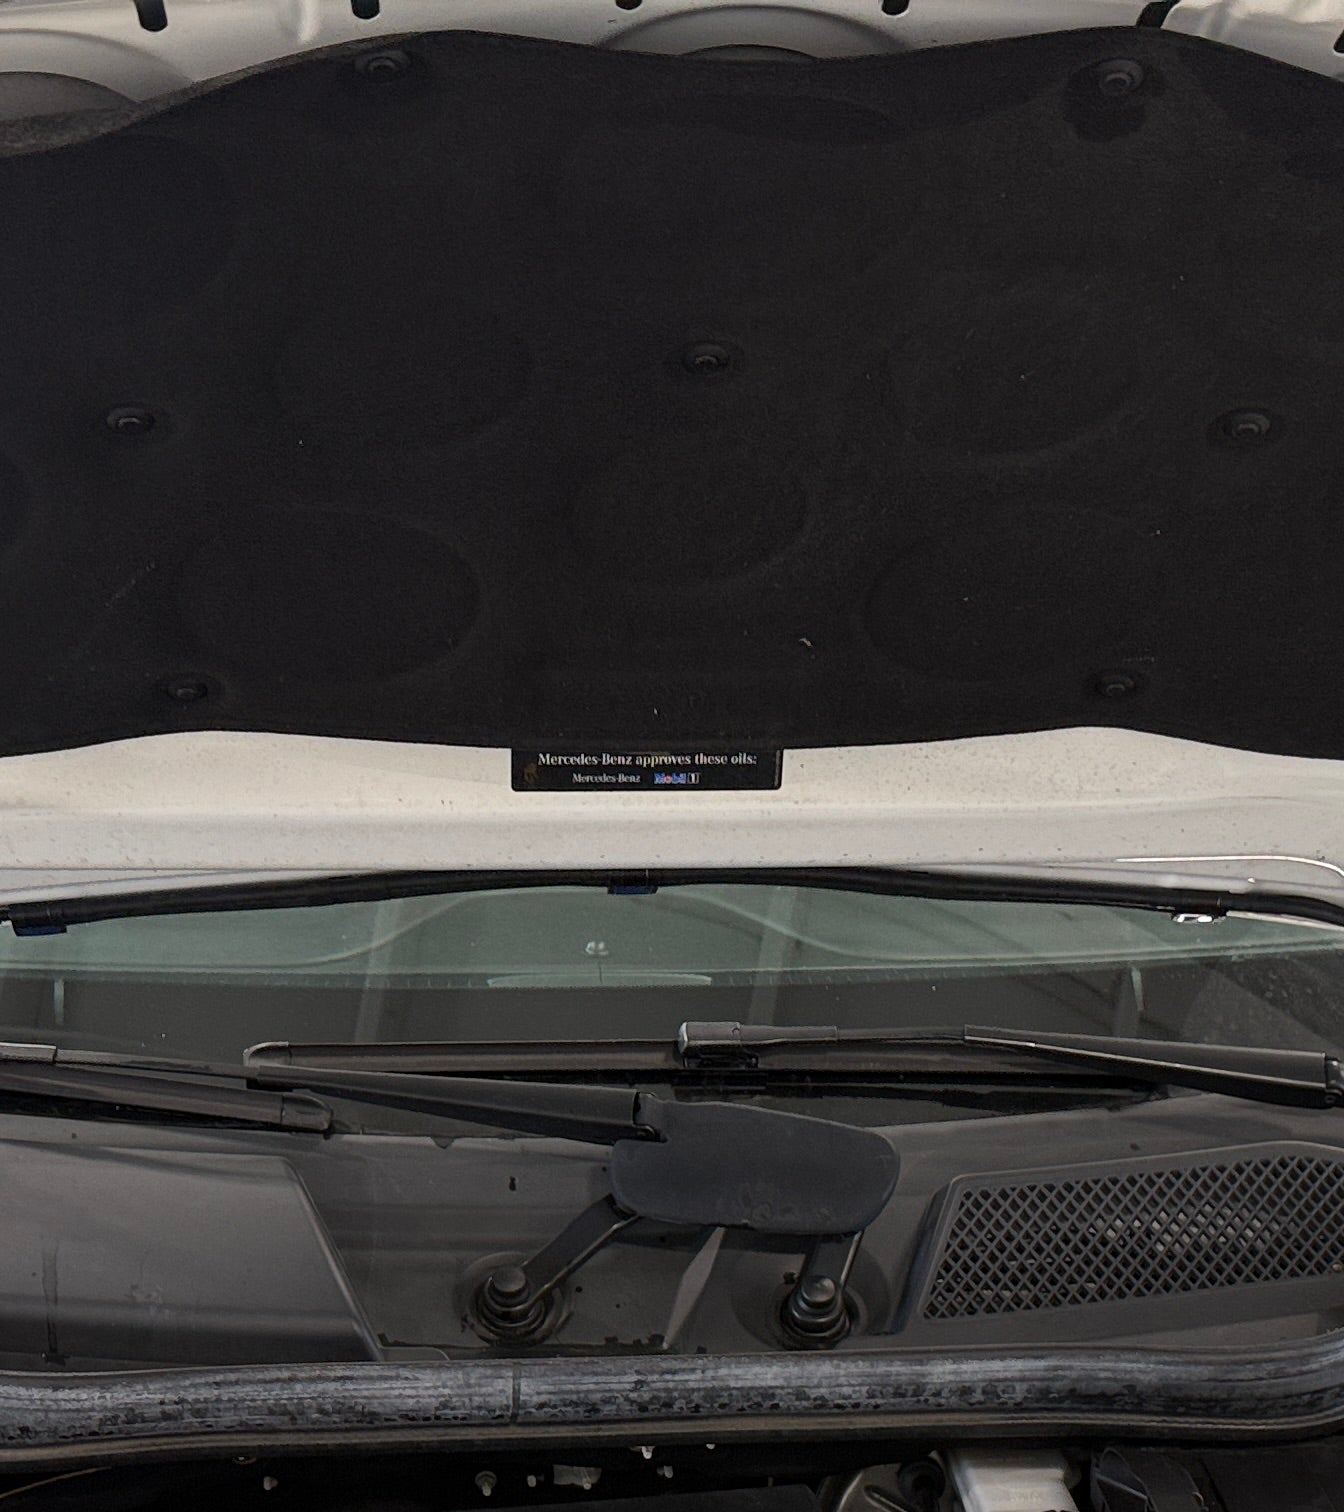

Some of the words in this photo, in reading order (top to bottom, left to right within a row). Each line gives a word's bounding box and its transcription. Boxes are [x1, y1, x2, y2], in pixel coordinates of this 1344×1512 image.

[538, 753, 632, 766] Mercedes-Benz
[636, 754, 691, 768] approves
[695, 752, 727, 764] these
[731, 753, 757, 765] oils:
[572, 773, 641, 783] Mercedes-Benz
